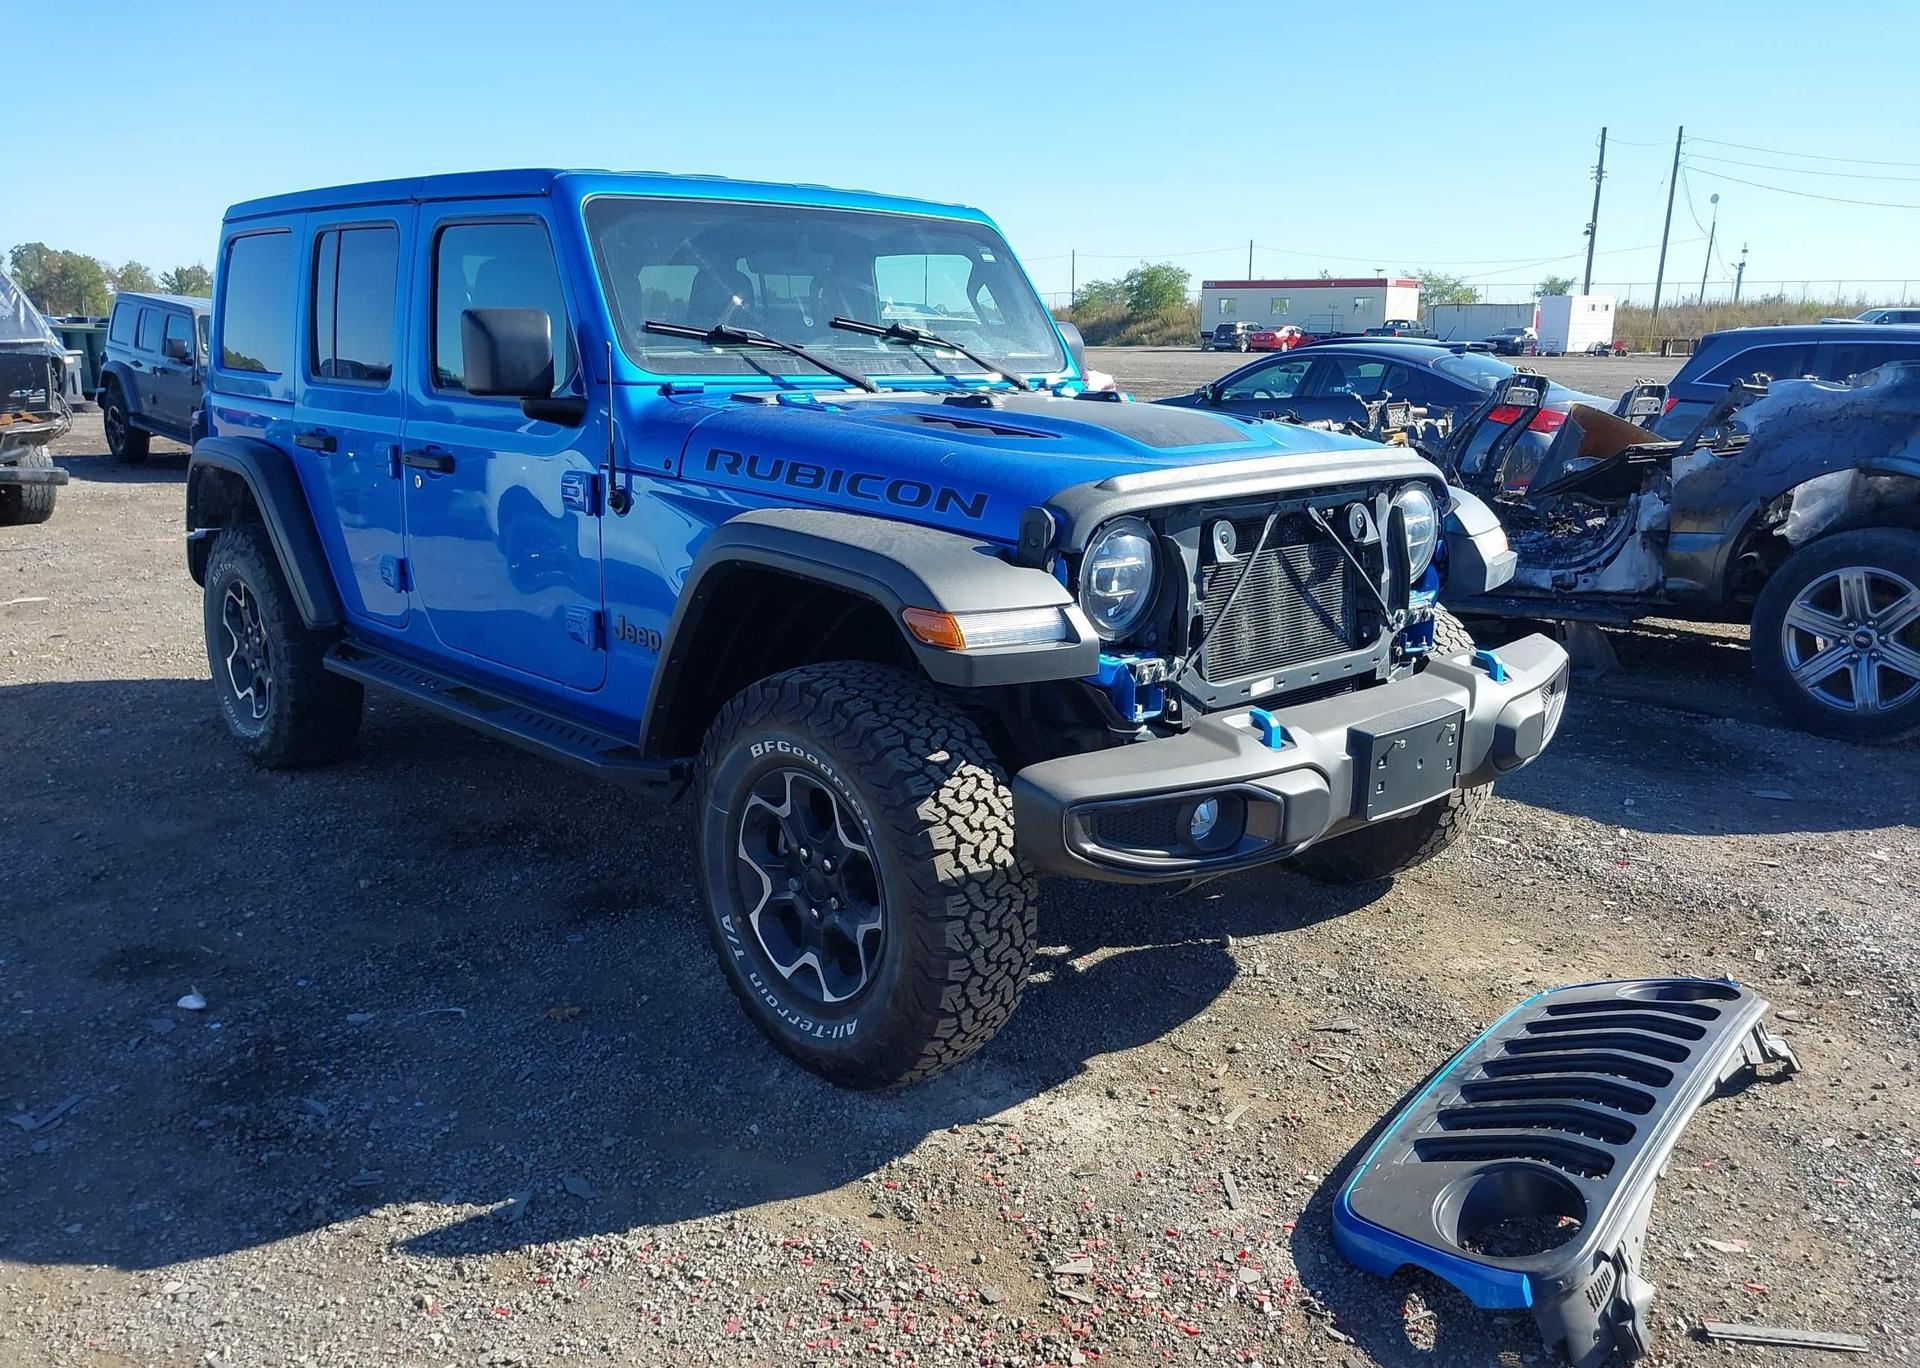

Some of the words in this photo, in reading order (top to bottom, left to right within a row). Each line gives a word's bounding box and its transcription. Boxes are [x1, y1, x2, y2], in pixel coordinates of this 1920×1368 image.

[704, 447, 990, 520] RUBICON
[612, 614, 663, 655] Jeep
[750, 740, 873, 836] BFGoodrich
[721, 914, 745, 961] T/A
[749, 972, 858, 1039] All-Terrain
